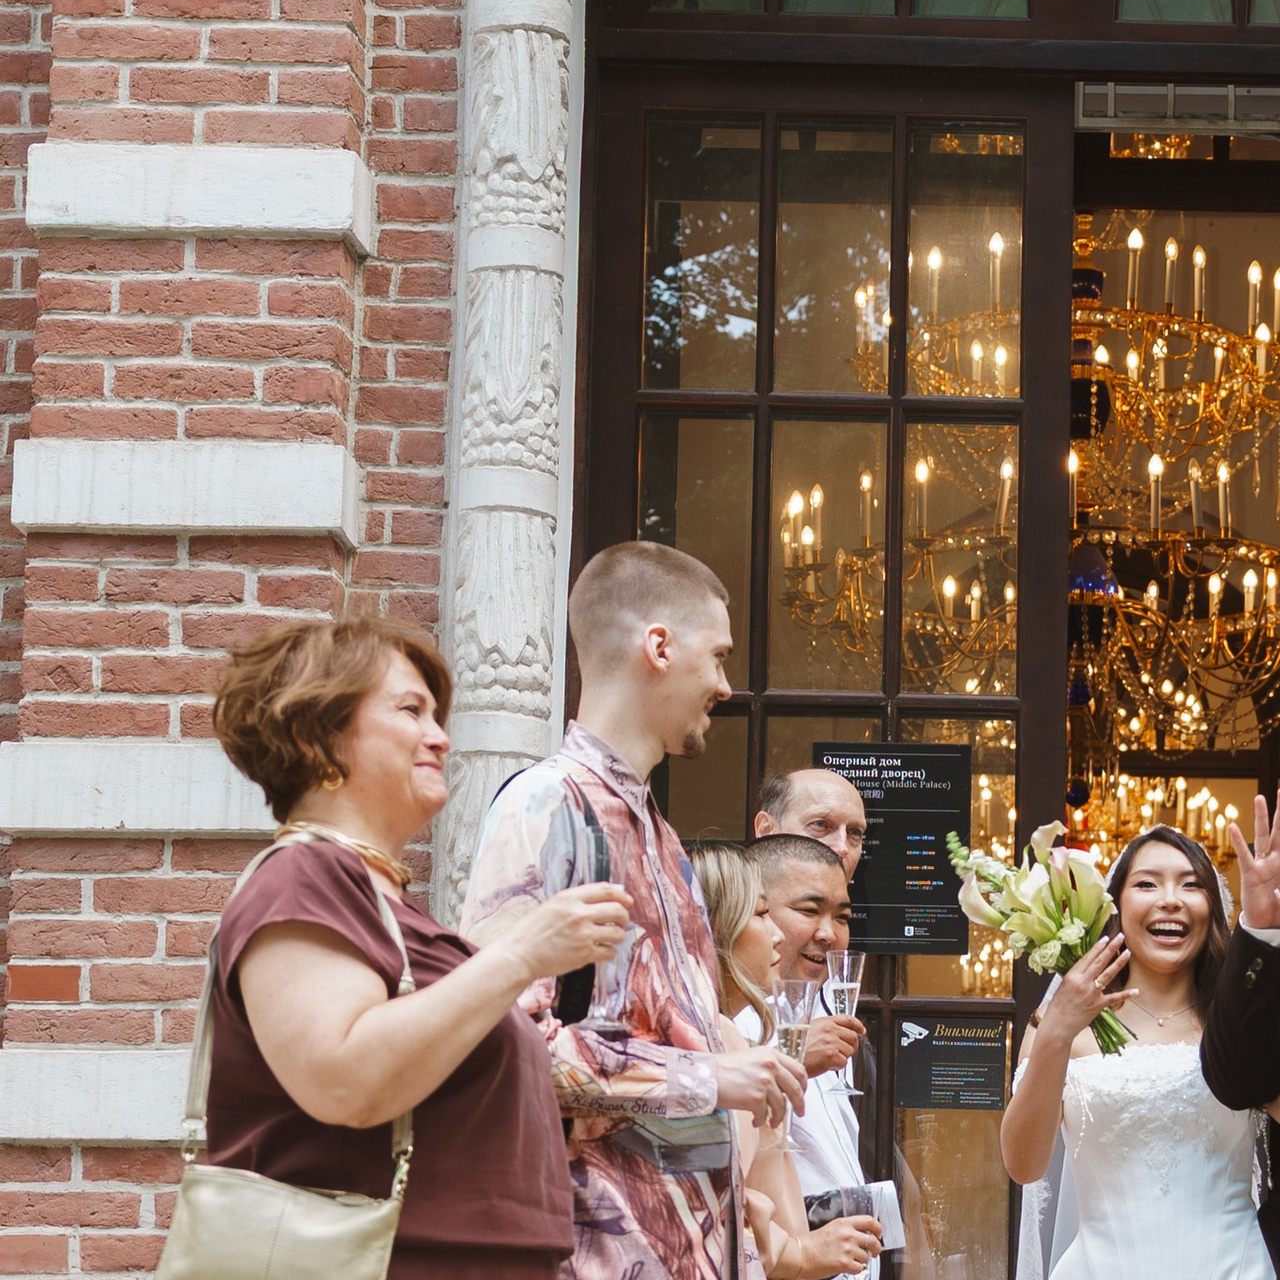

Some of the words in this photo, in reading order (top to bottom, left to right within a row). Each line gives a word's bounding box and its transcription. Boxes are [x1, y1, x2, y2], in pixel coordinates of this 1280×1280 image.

[823, 755, 876, 767] Оперный
[879, 758, 902, 767] дом
[880, 769, 926, 780] дворец)
[882, 780, 918, 790] (Middle
[920, 780, 951, 791] Palace)
[933, 1021, 1004, 1038] Внимание!
